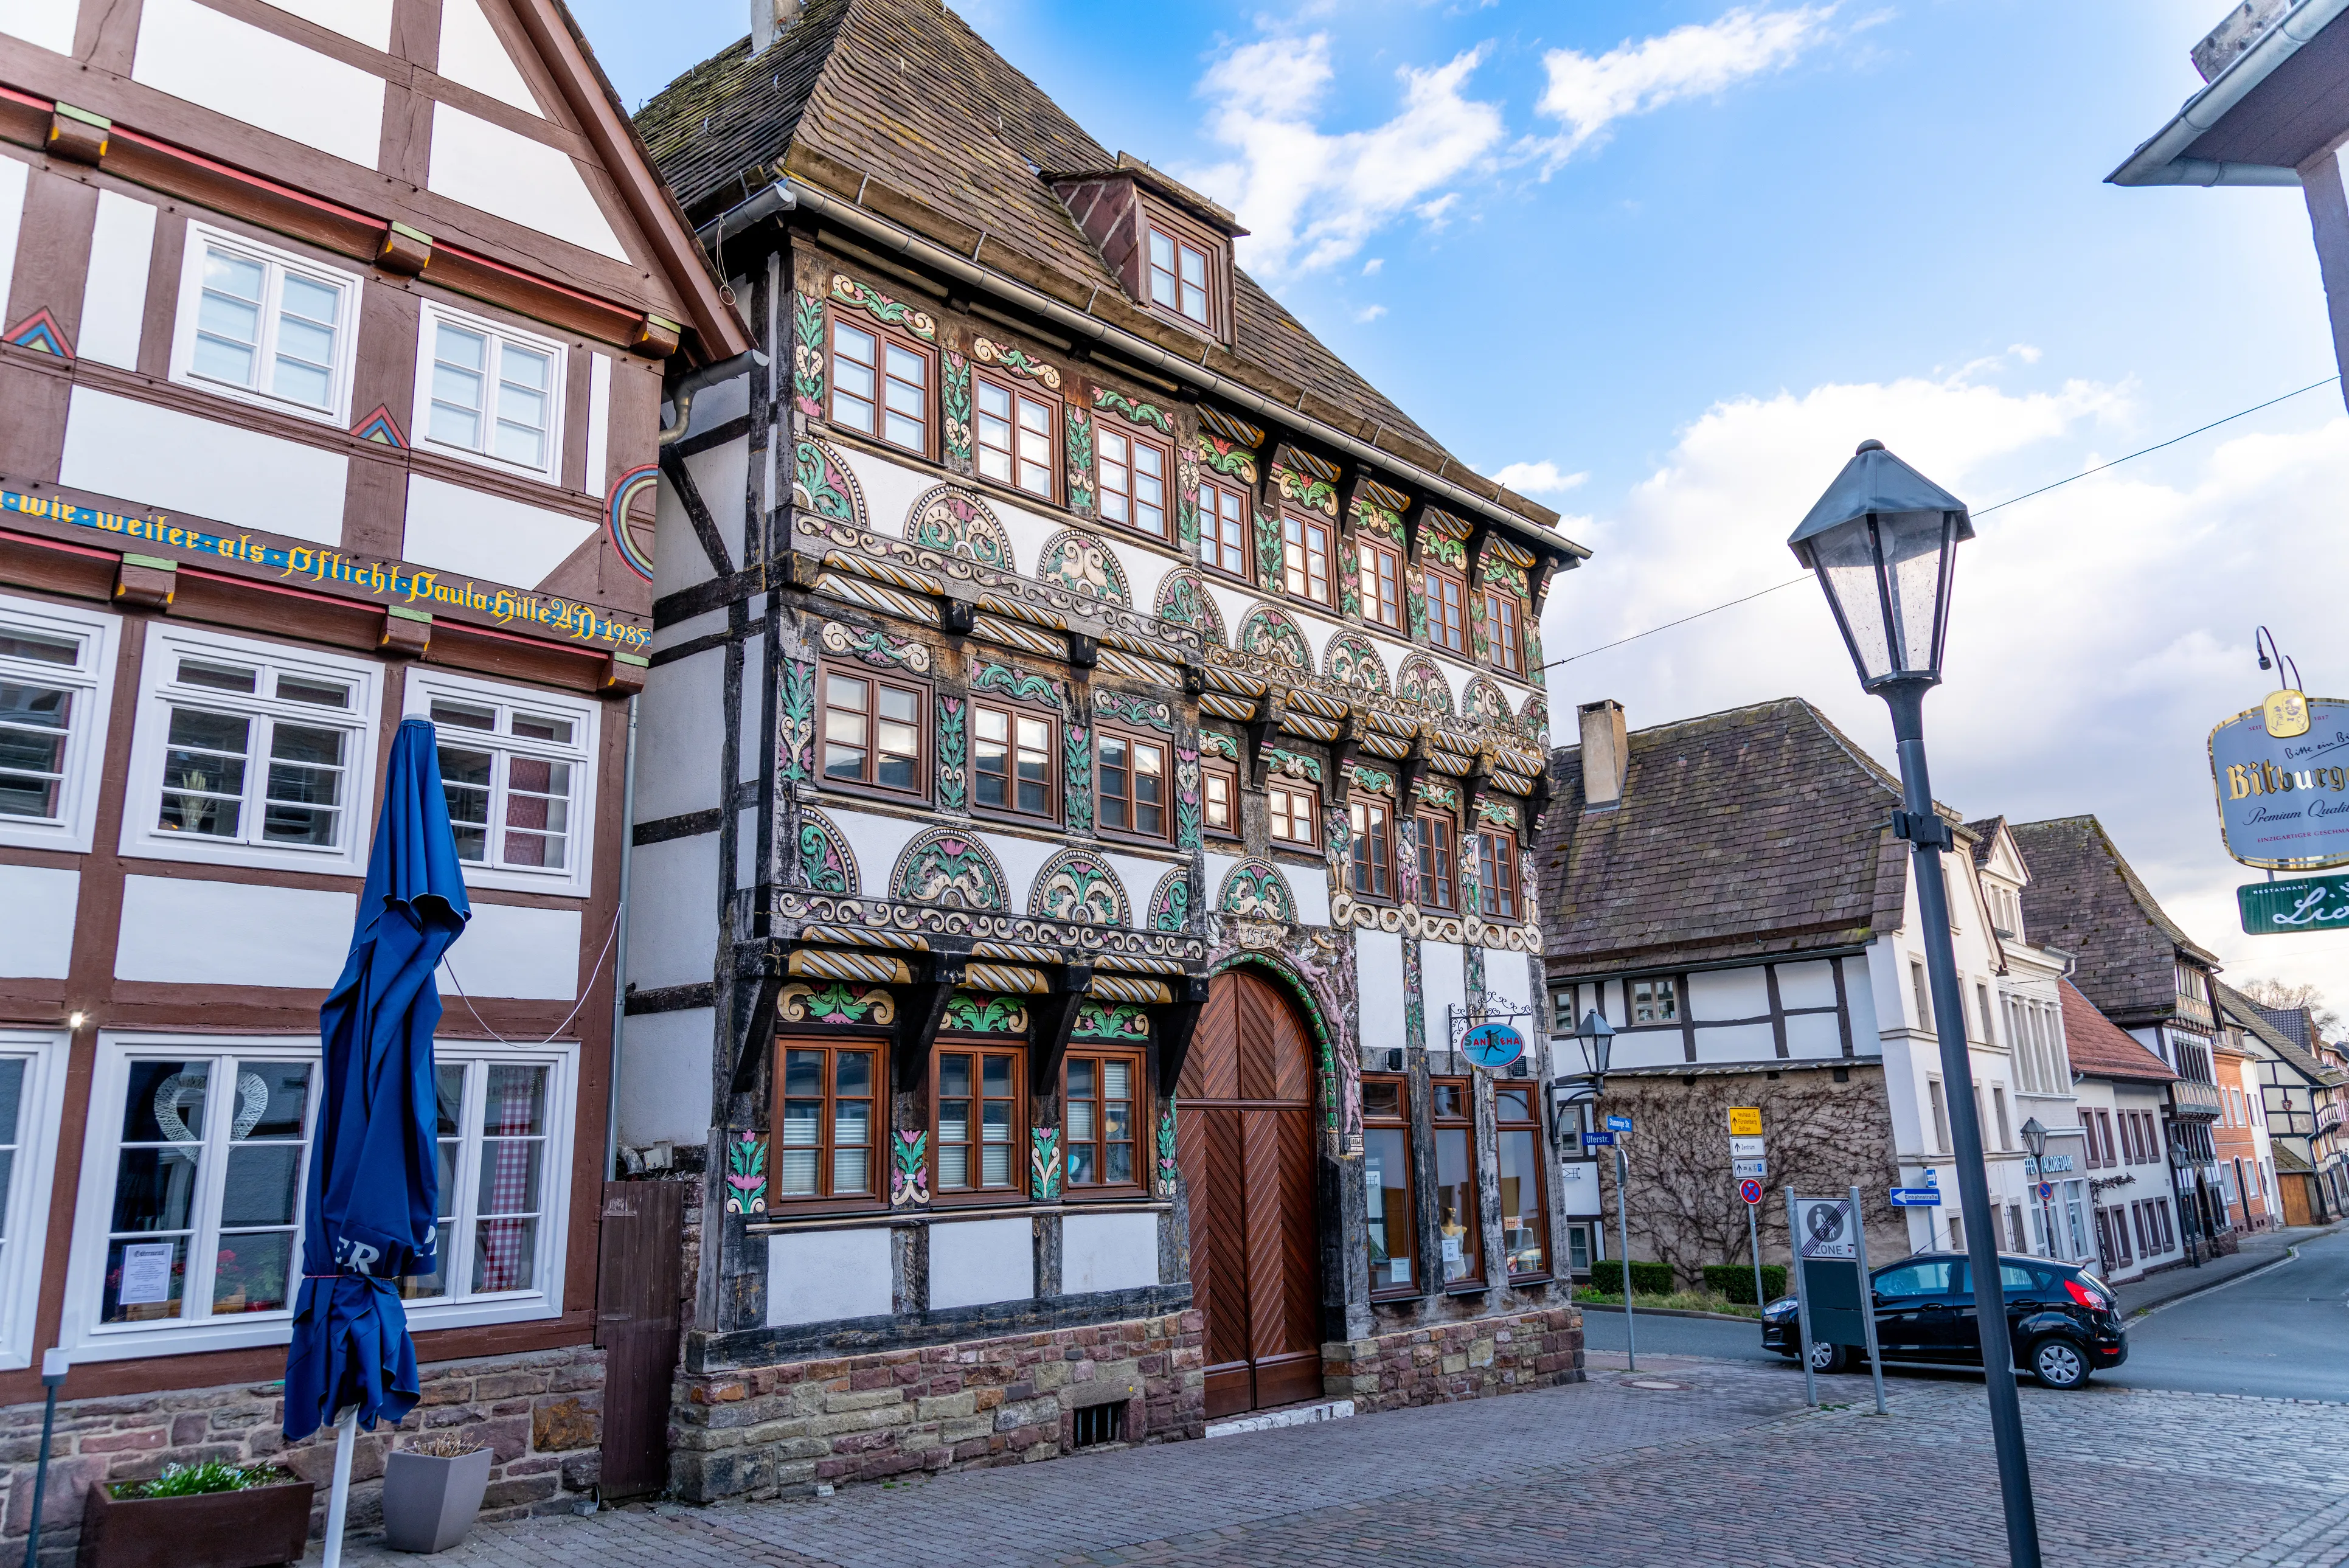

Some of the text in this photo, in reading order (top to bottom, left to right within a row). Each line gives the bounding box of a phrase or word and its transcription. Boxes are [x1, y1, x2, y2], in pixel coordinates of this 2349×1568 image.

[96, 512, 200, 549] weiter
[218, 534, 266, 563] als
[280, 546, 401, 594] Pflicht
[404, 571, 488, 610] Paula
[491, 589, 550, 626] Hille
[2285, 746, 2313, 759] Bitte
[2243, 807, 2302, 825] Premium
[2257, 832, 2311, 843] EINZIGARTIGER
[2253, 884, 2309, 895] RESTAURANT
[1586, 1135, 1609, 1143] Uferstr.
[1815, 1244, 1843, 1255] ZONE
